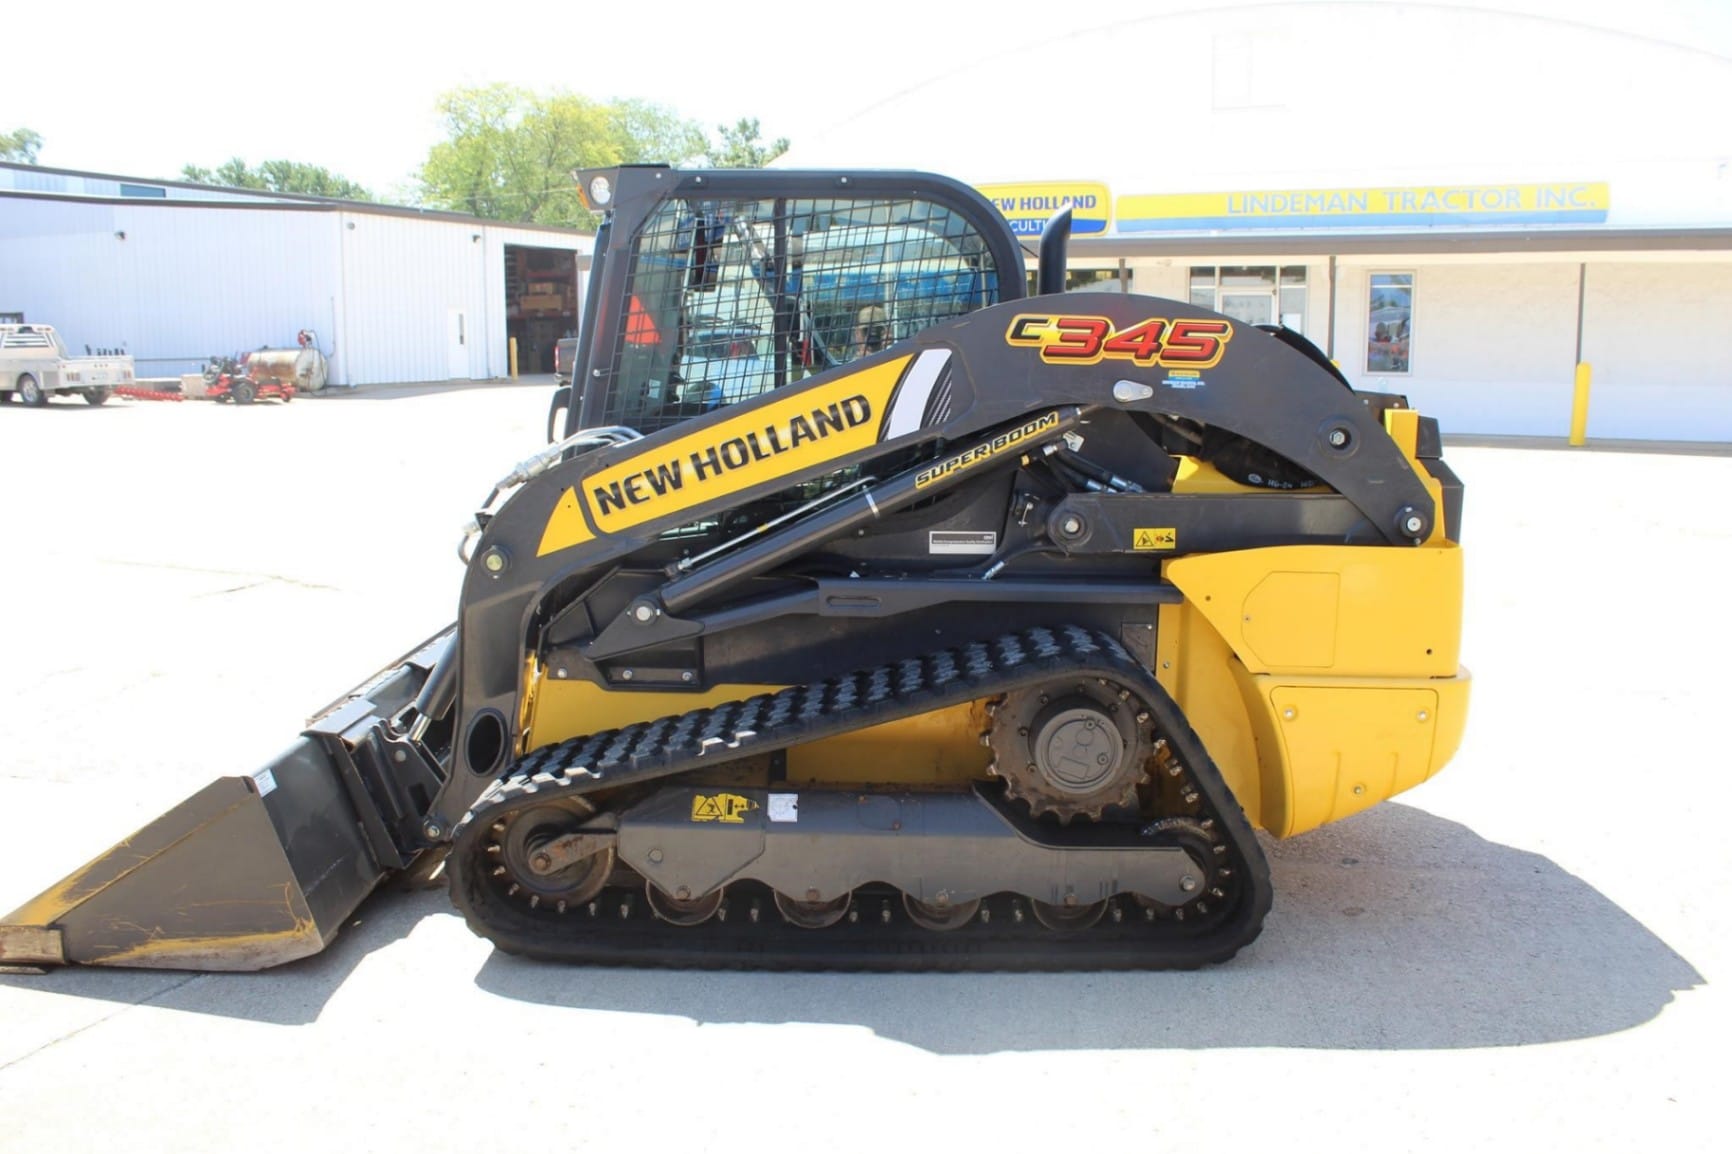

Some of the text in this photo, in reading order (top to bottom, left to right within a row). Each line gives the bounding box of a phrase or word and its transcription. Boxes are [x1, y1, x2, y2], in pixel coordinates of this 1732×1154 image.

[991, 195, 1097, 212] EW HOLLAND
[1227, 186, 1596, 214] LINDEMAN TRACTOR INC.
[1007, 315, 1231, 365] C345
[593, 394, 872, 516] NEW HOLLAND
[916, 412, 1058, 487] SUPER BOOM
